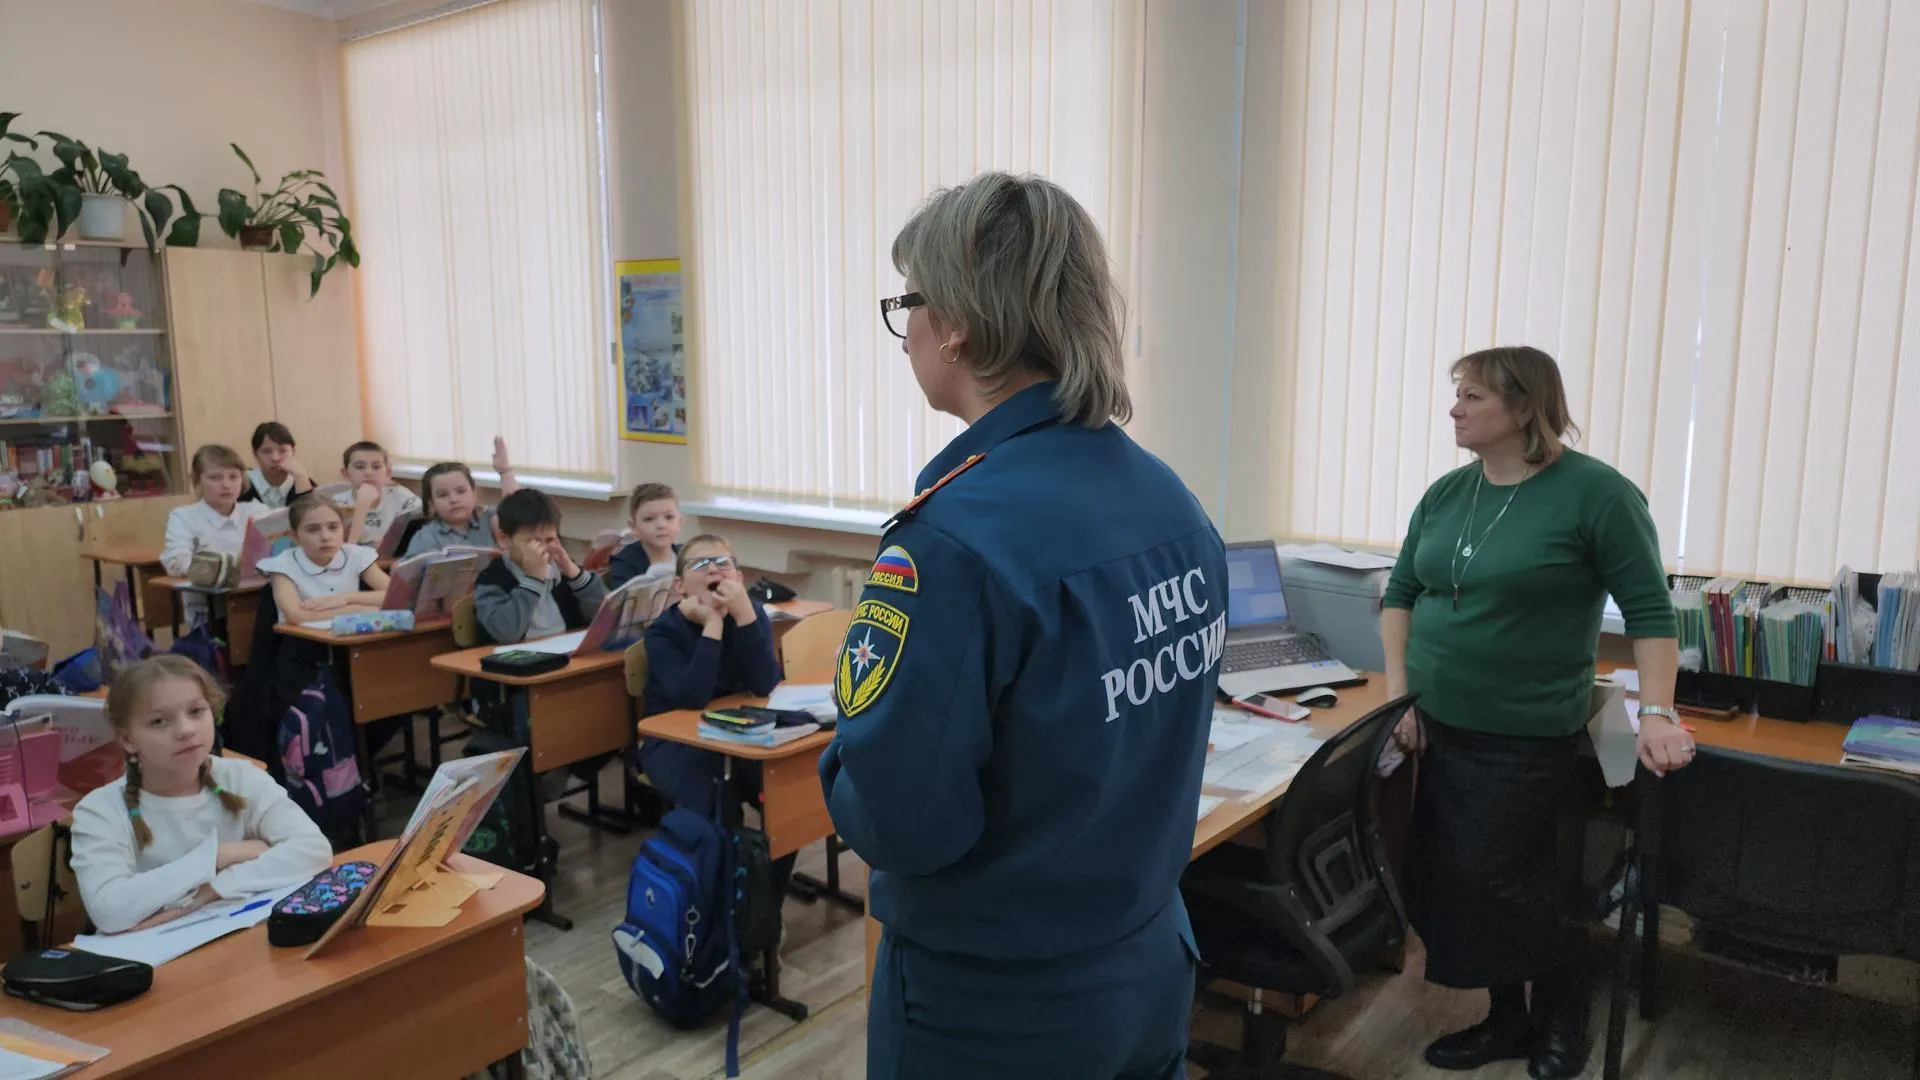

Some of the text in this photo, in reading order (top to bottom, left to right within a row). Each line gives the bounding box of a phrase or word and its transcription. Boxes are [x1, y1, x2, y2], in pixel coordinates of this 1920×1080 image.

[872, 571, 904, 586] РОССИЯ
[868, 604, 904, 632] РОССИИ
[1128, 566, 1209, 645] МЧС
[1101, 610, 1226, 723] РОССИИ
